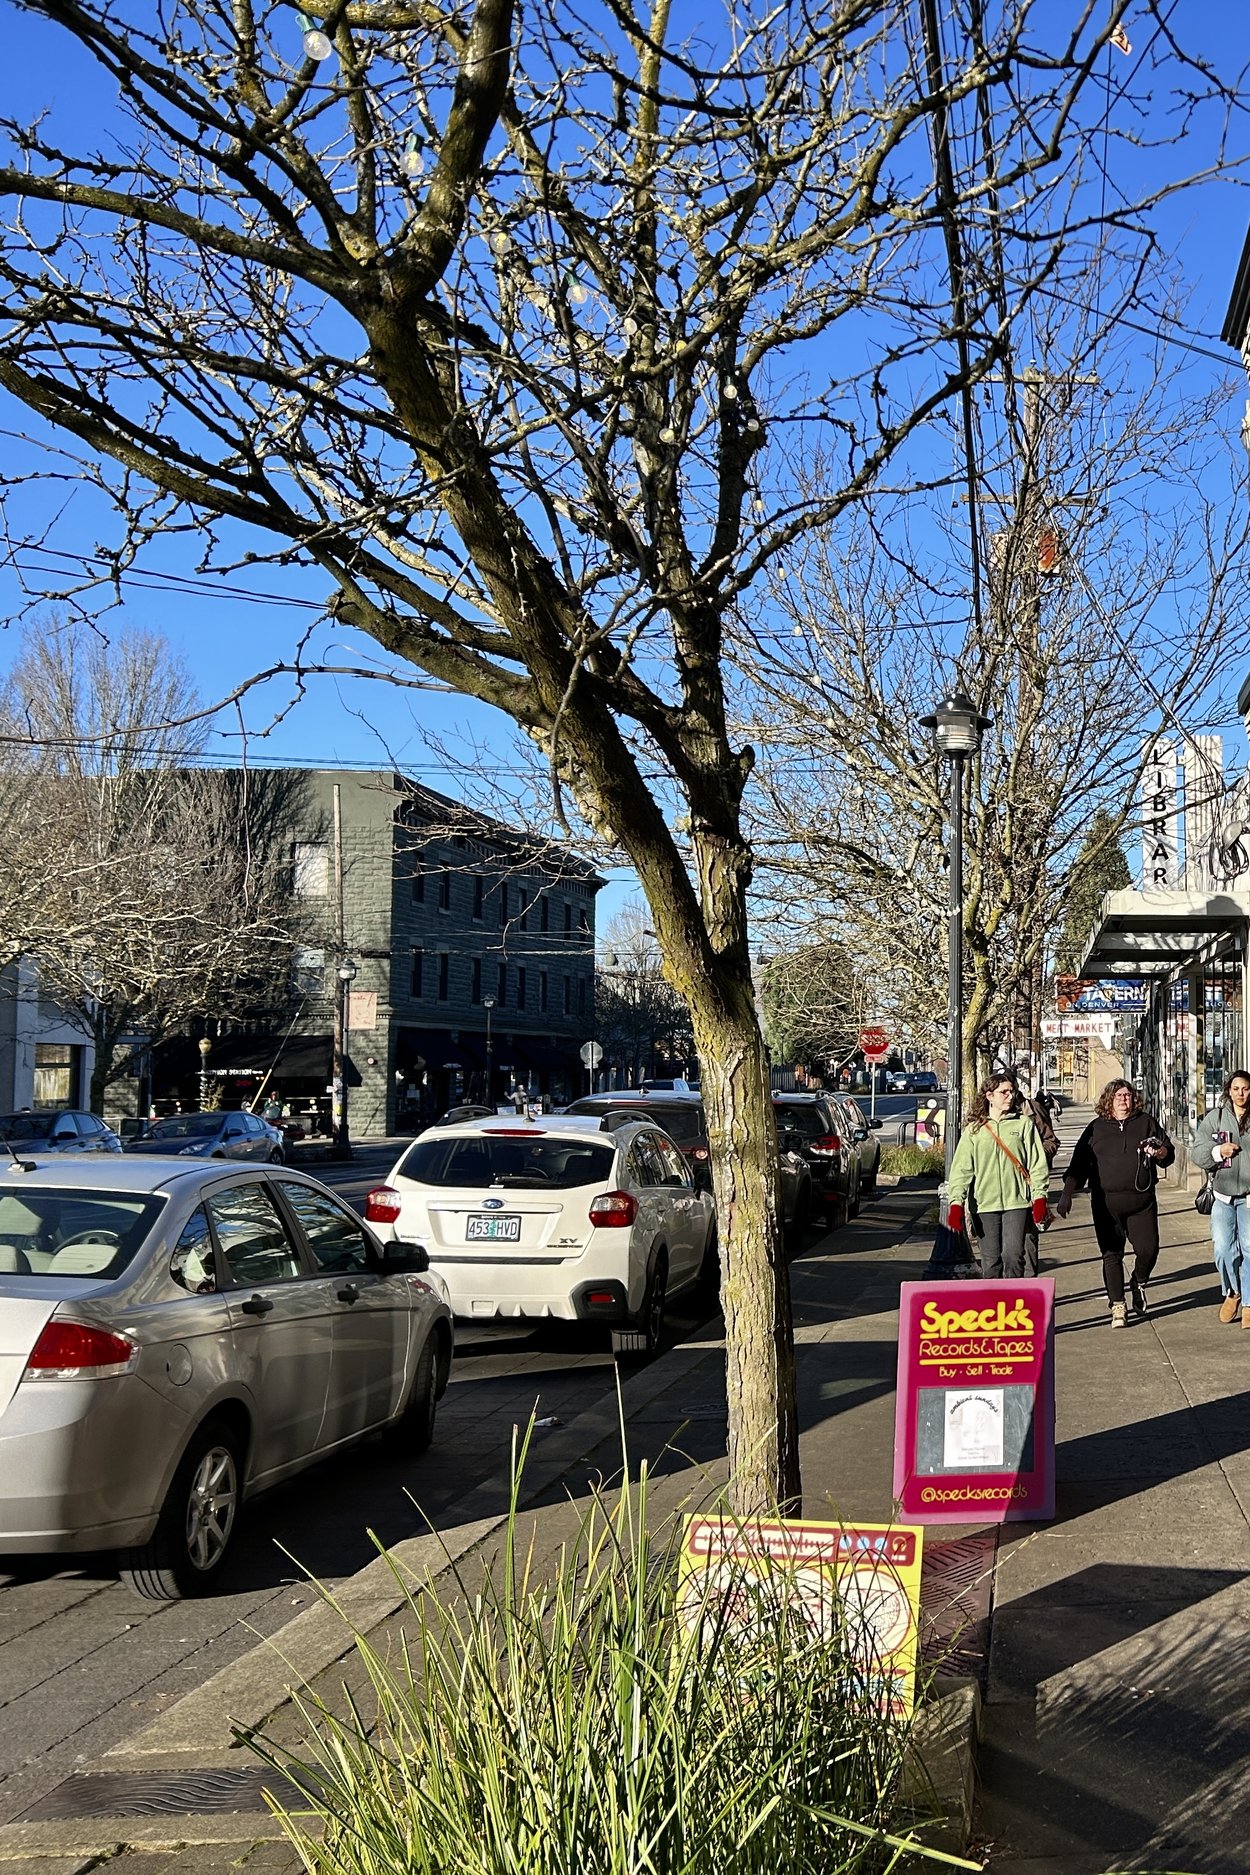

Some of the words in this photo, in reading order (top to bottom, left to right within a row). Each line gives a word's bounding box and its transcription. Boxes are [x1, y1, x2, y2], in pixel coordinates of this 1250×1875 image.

[1074, 1022, 1112, 1033] MARKET
[469, 1222, 489, 1236] 453
[497, 1223, 517, 1238] HVD
[920, 1299, 1034, 1338] Speck's
[939, 1366, 957, 1378] Buy
[966, 1366, 982, 1375] Sell
[990, 1364, 1013, 1375] Trade
[921, 1484, 1028, 1503] @specksrecords
